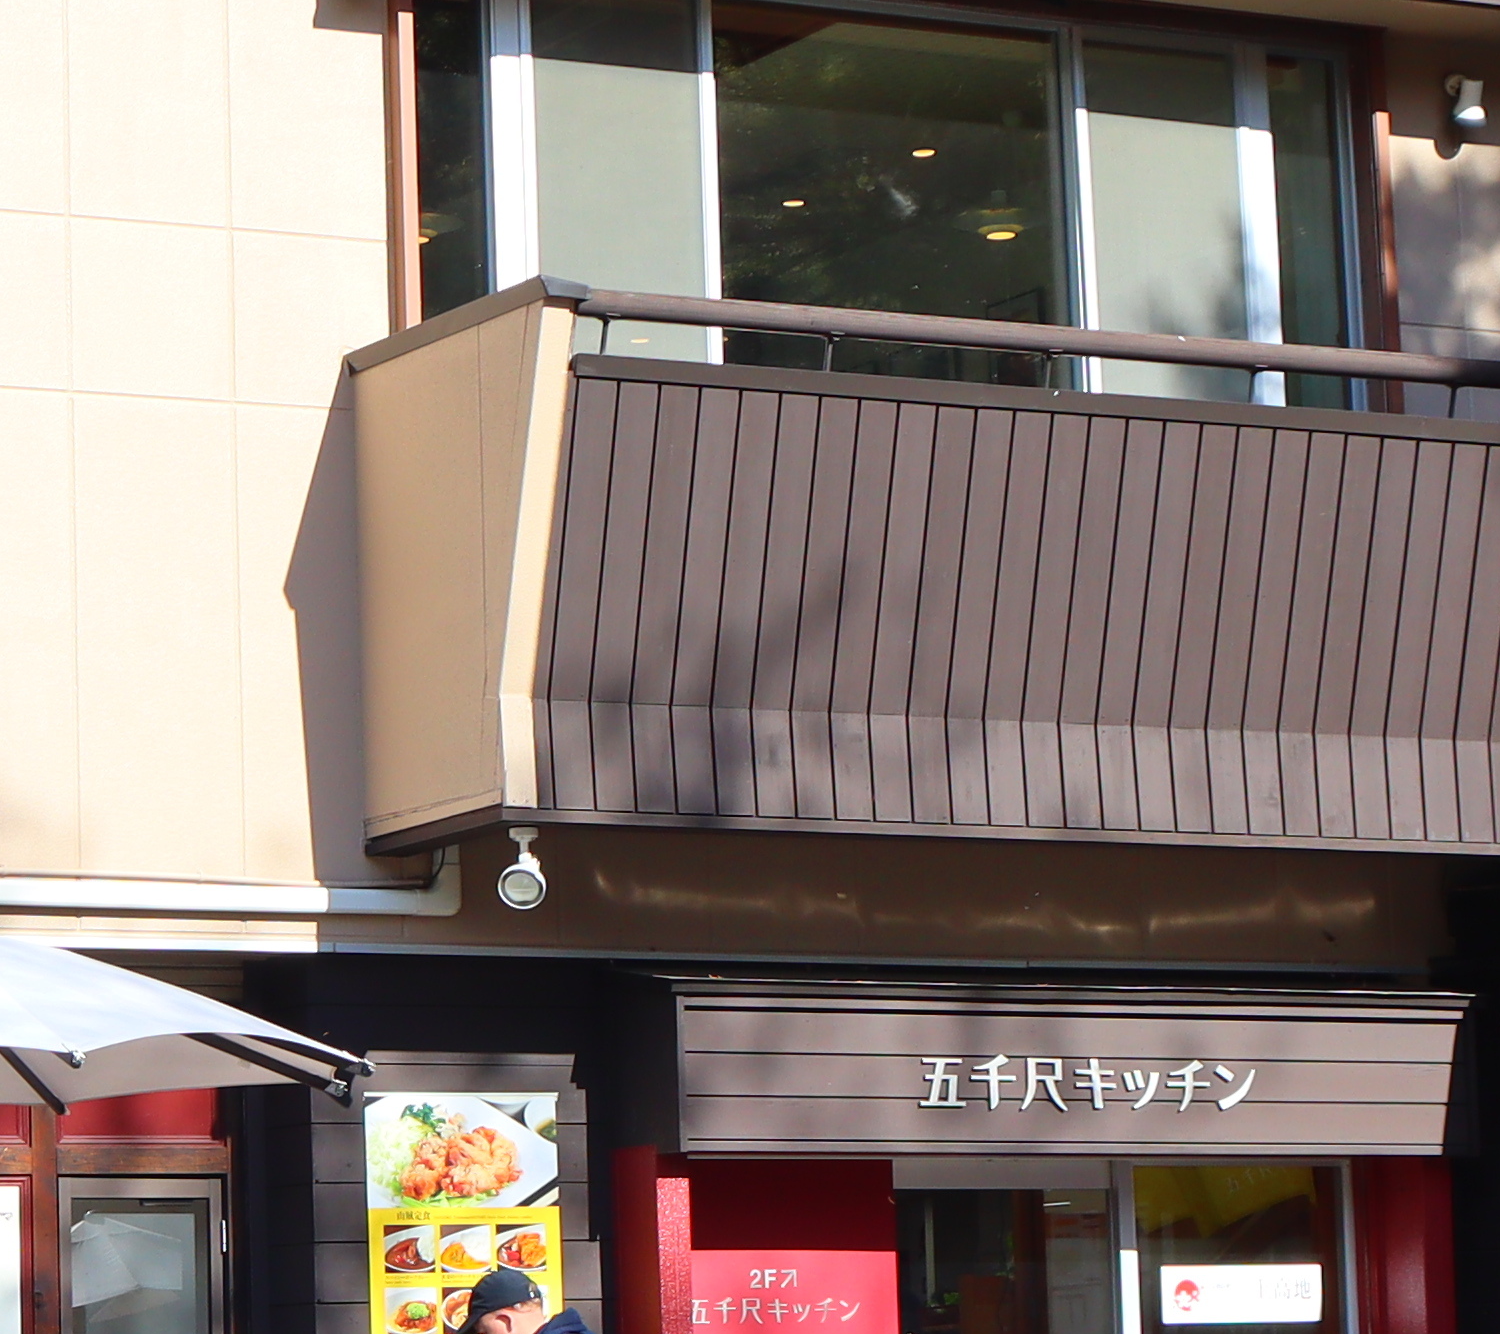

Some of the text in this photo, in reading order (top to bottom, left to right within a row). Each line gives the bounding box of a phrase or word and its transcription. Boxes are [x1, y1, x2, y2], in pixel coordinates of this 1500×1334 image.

[918, 1054, 1256, 1113] 五千尺キッチン
[749, 1269, 777, 1289] 2F
[690, 1297, 861, 1325] 五千尺キッチン
